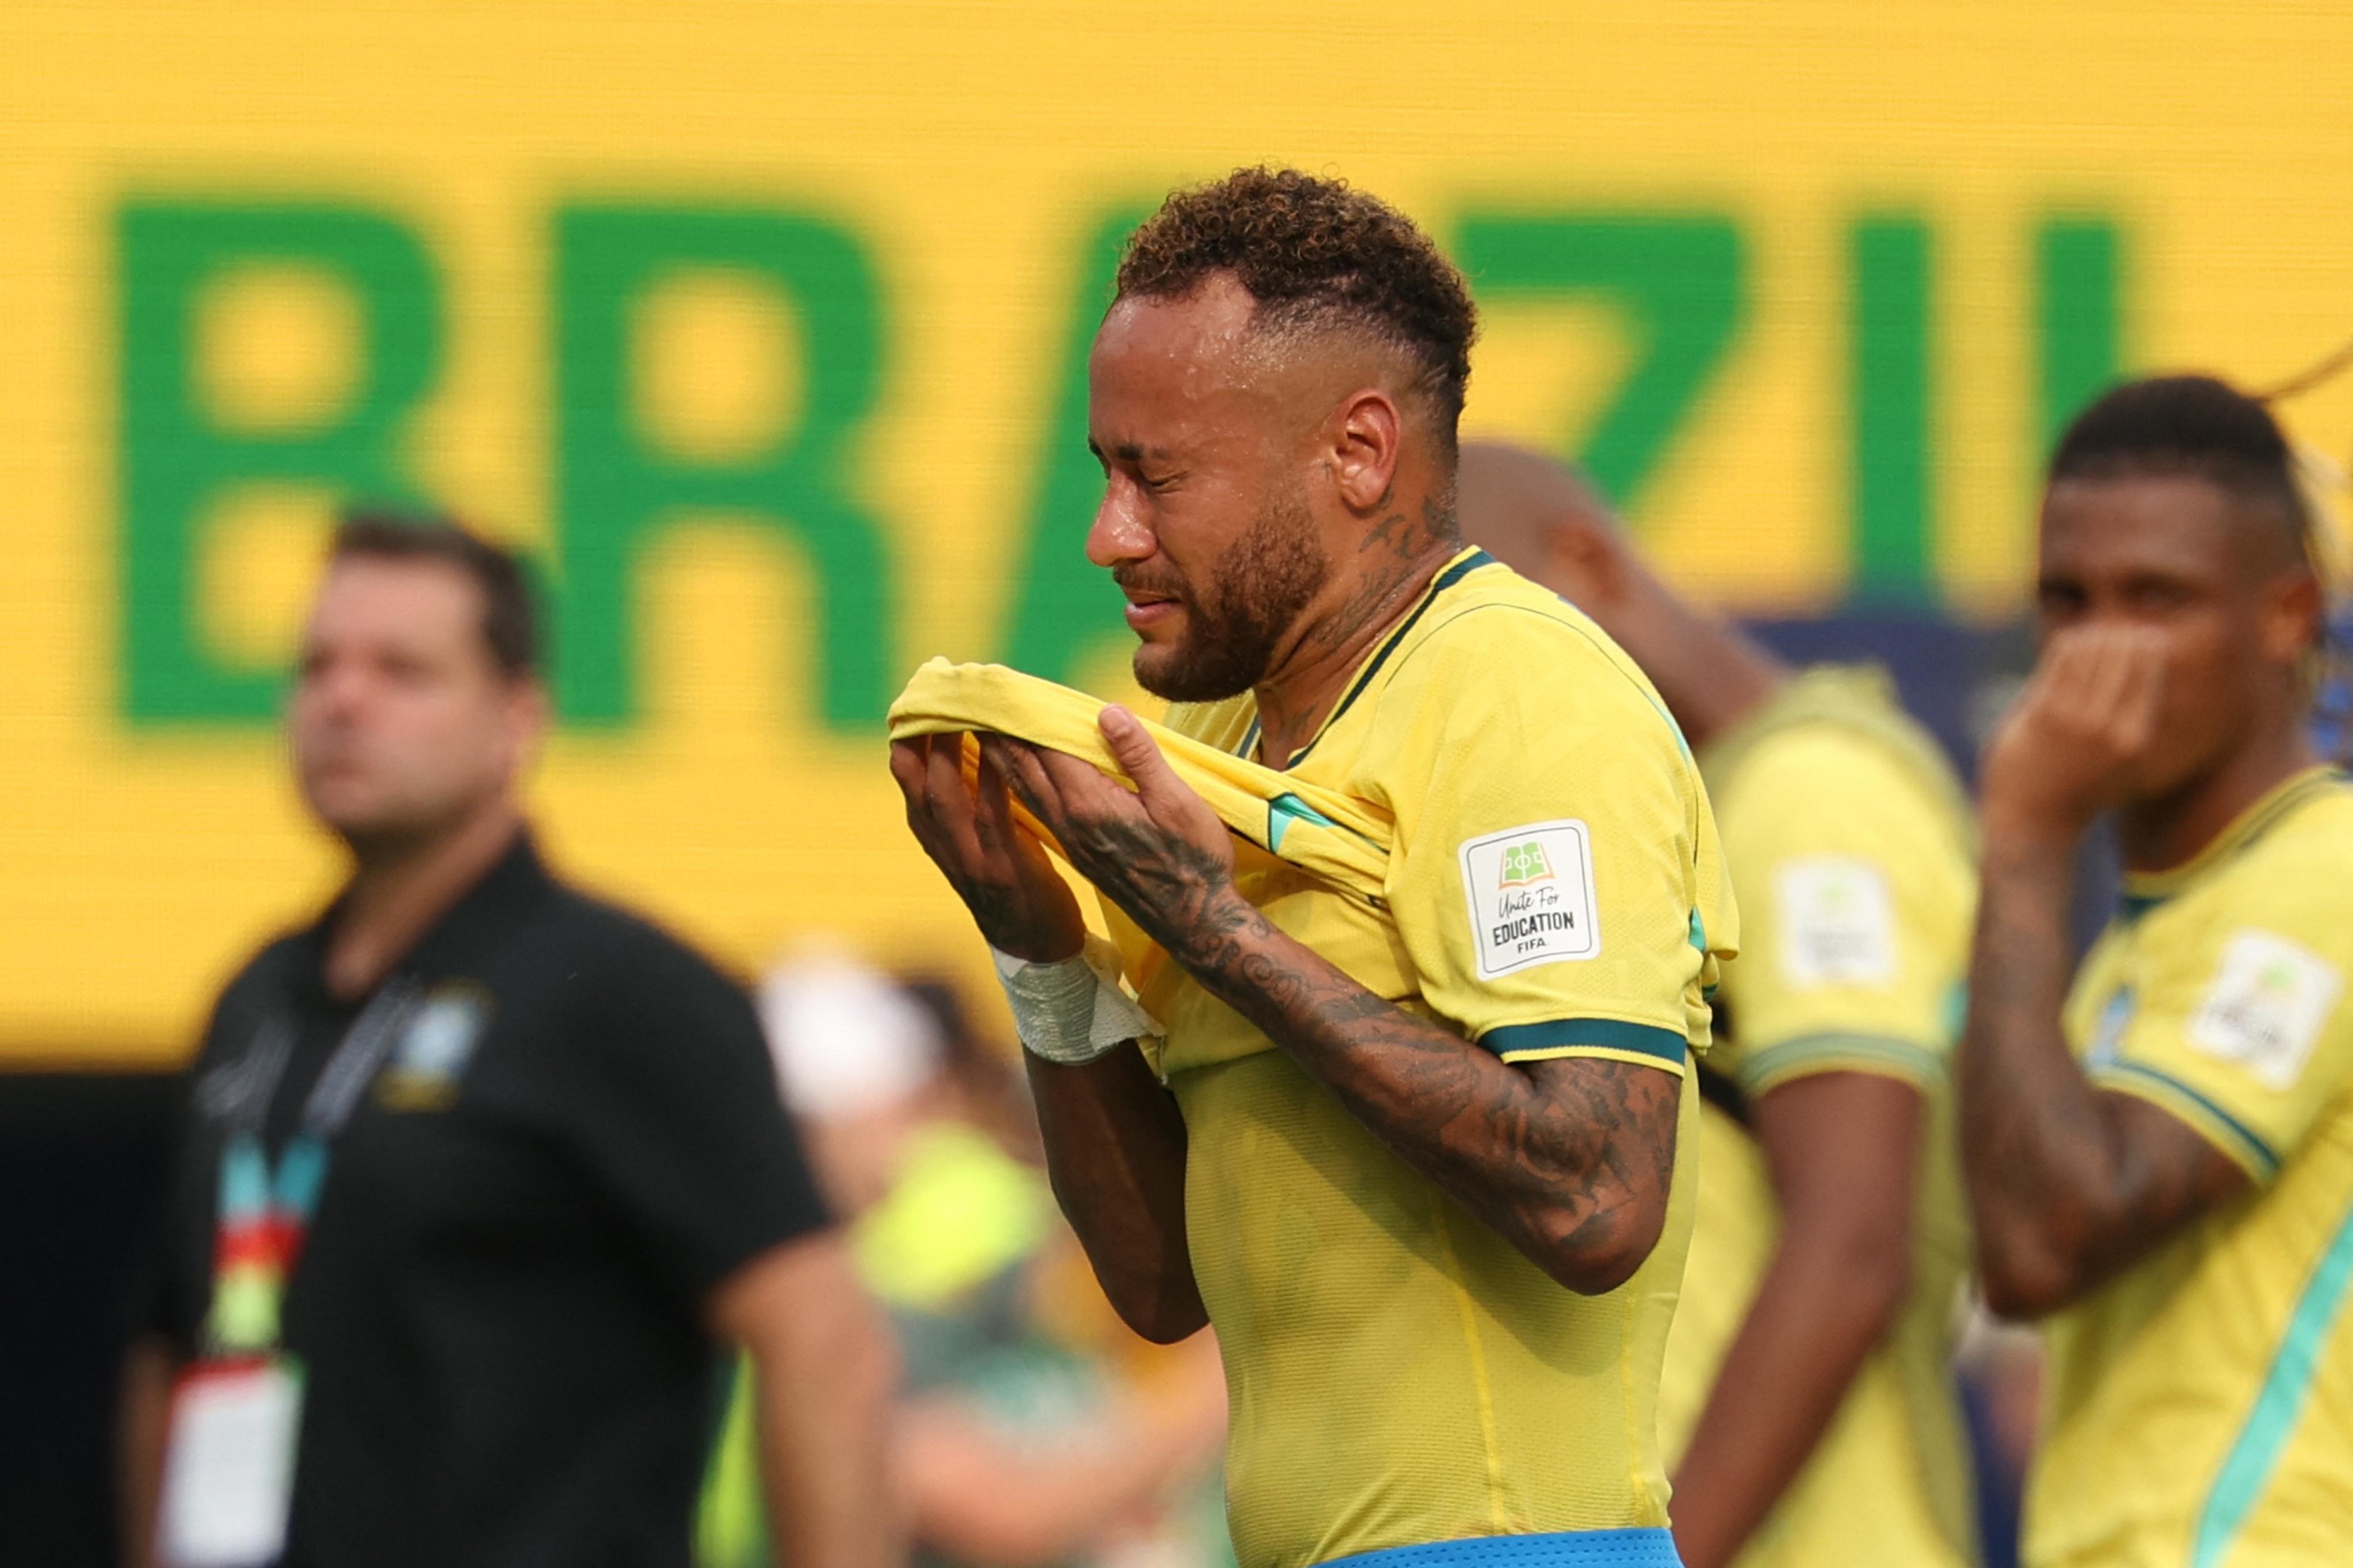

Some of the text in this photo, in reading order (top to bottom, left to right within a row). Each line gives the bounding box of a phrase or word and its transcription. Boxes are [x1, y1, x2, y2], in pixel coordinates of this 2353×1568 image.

[1498, 886, 1560, 919] Unite For
[1493, 912, 1574, 947] EDUCATION
[1517, 937, 1546, 954] FIFA
